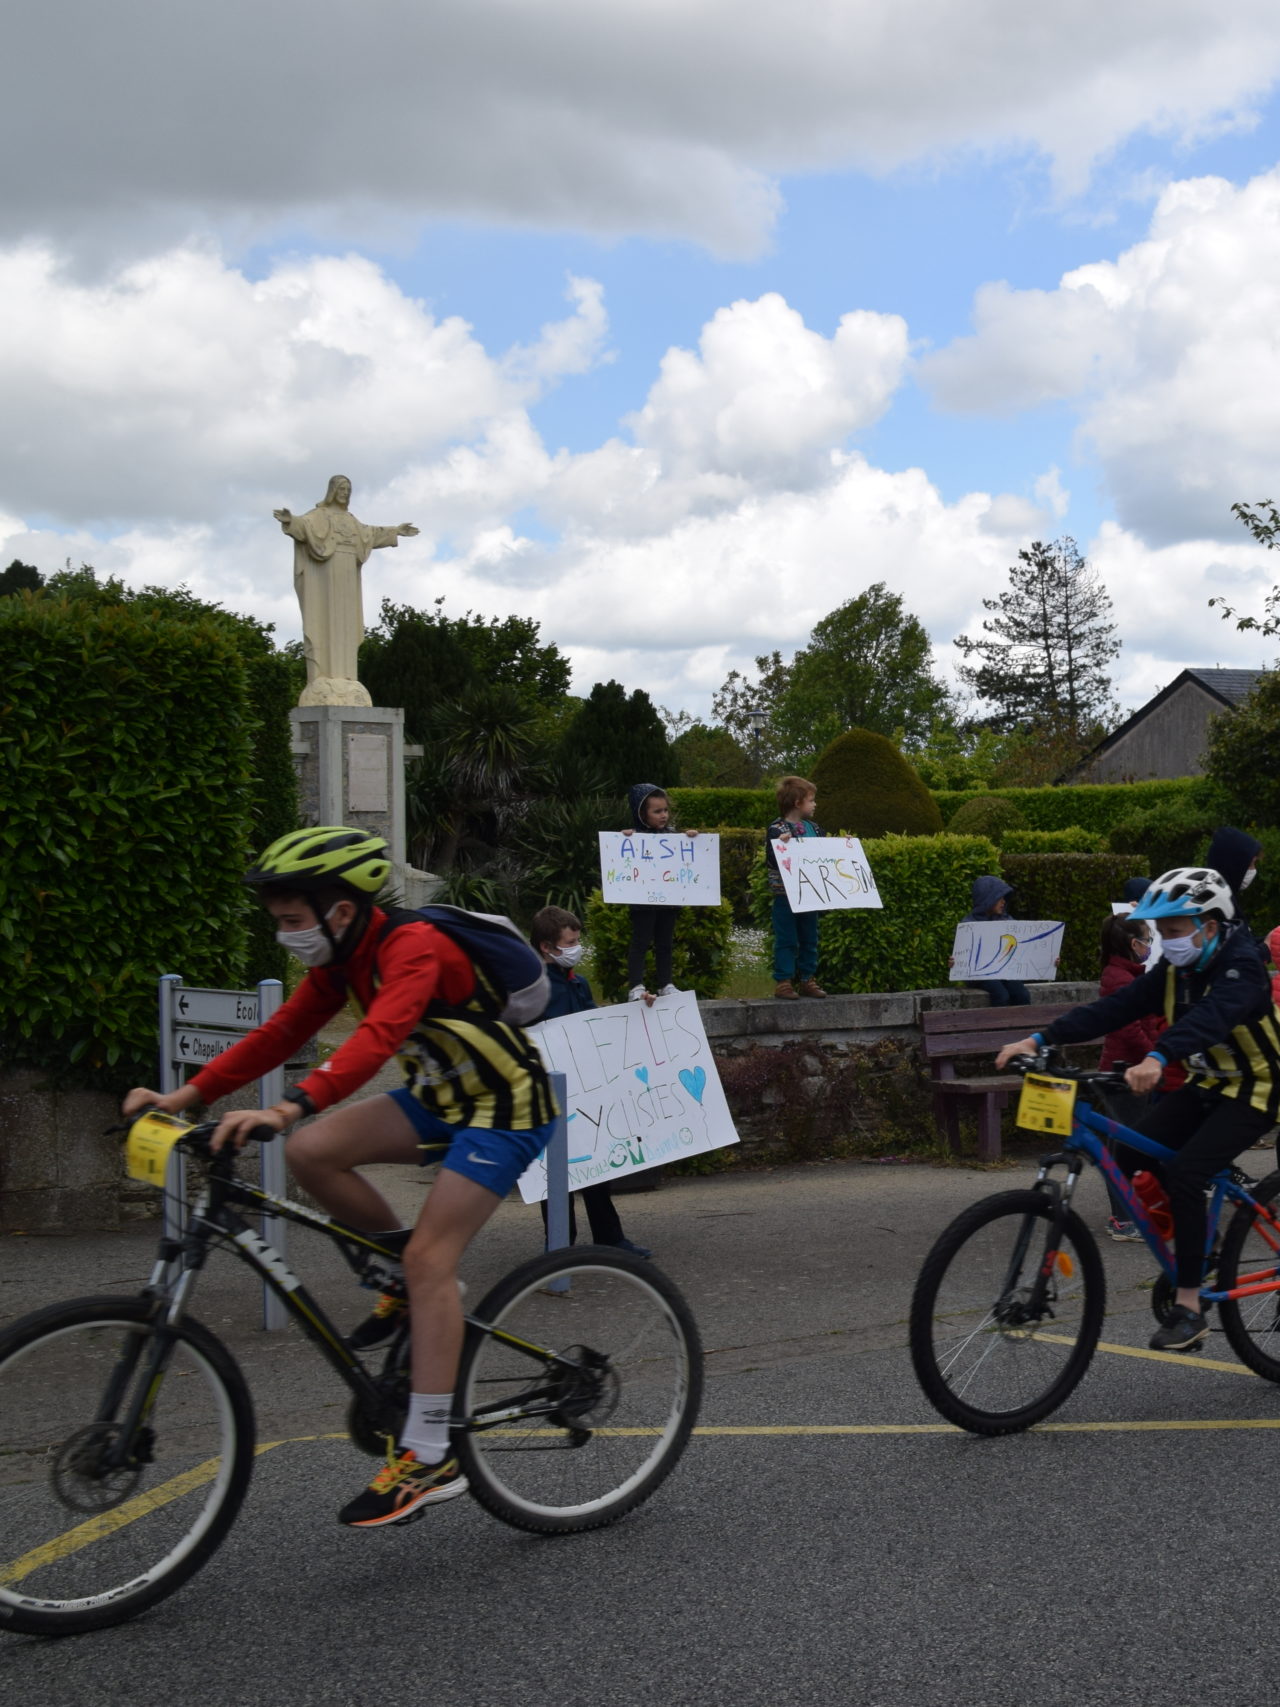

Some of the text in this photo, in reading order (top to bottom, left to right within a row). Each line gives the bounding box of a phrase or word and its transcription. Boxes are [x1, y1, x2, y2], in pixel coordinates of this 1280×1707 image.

[620, 838, 695, 862] ALSH
[236, 996, 260, 1021] Écol
[641, 1005, 702, 1067] LES
[192, 1038, 224, 1061] Chapelle
